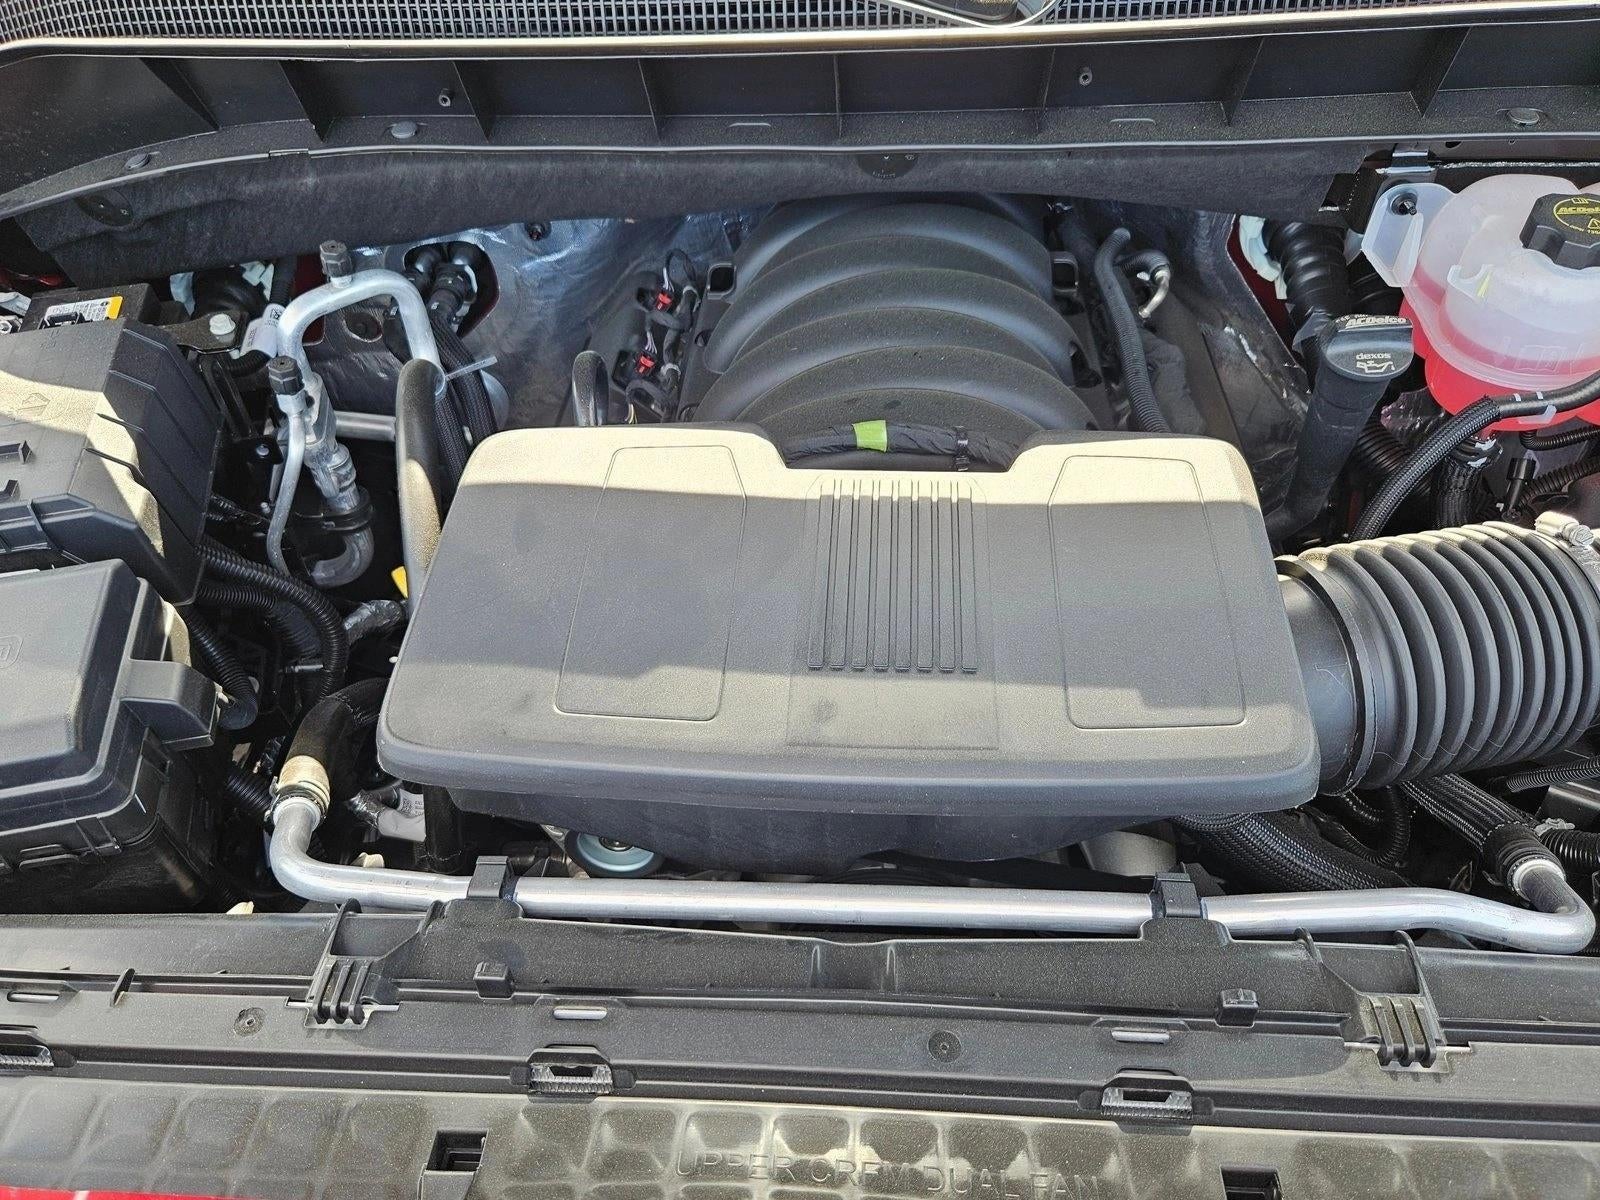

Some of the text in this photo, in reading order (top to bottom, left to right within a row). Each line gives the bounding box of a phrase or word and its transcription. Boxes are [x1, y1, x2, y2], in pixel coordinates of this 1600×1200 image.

[1345, 316, 1407, 328] ACDelco
[676, 1150, 797, 1181] UPPER
[923, 1165, 1020, 1198] DUAL
[1030, 1172, 1102, 1200] FAN
